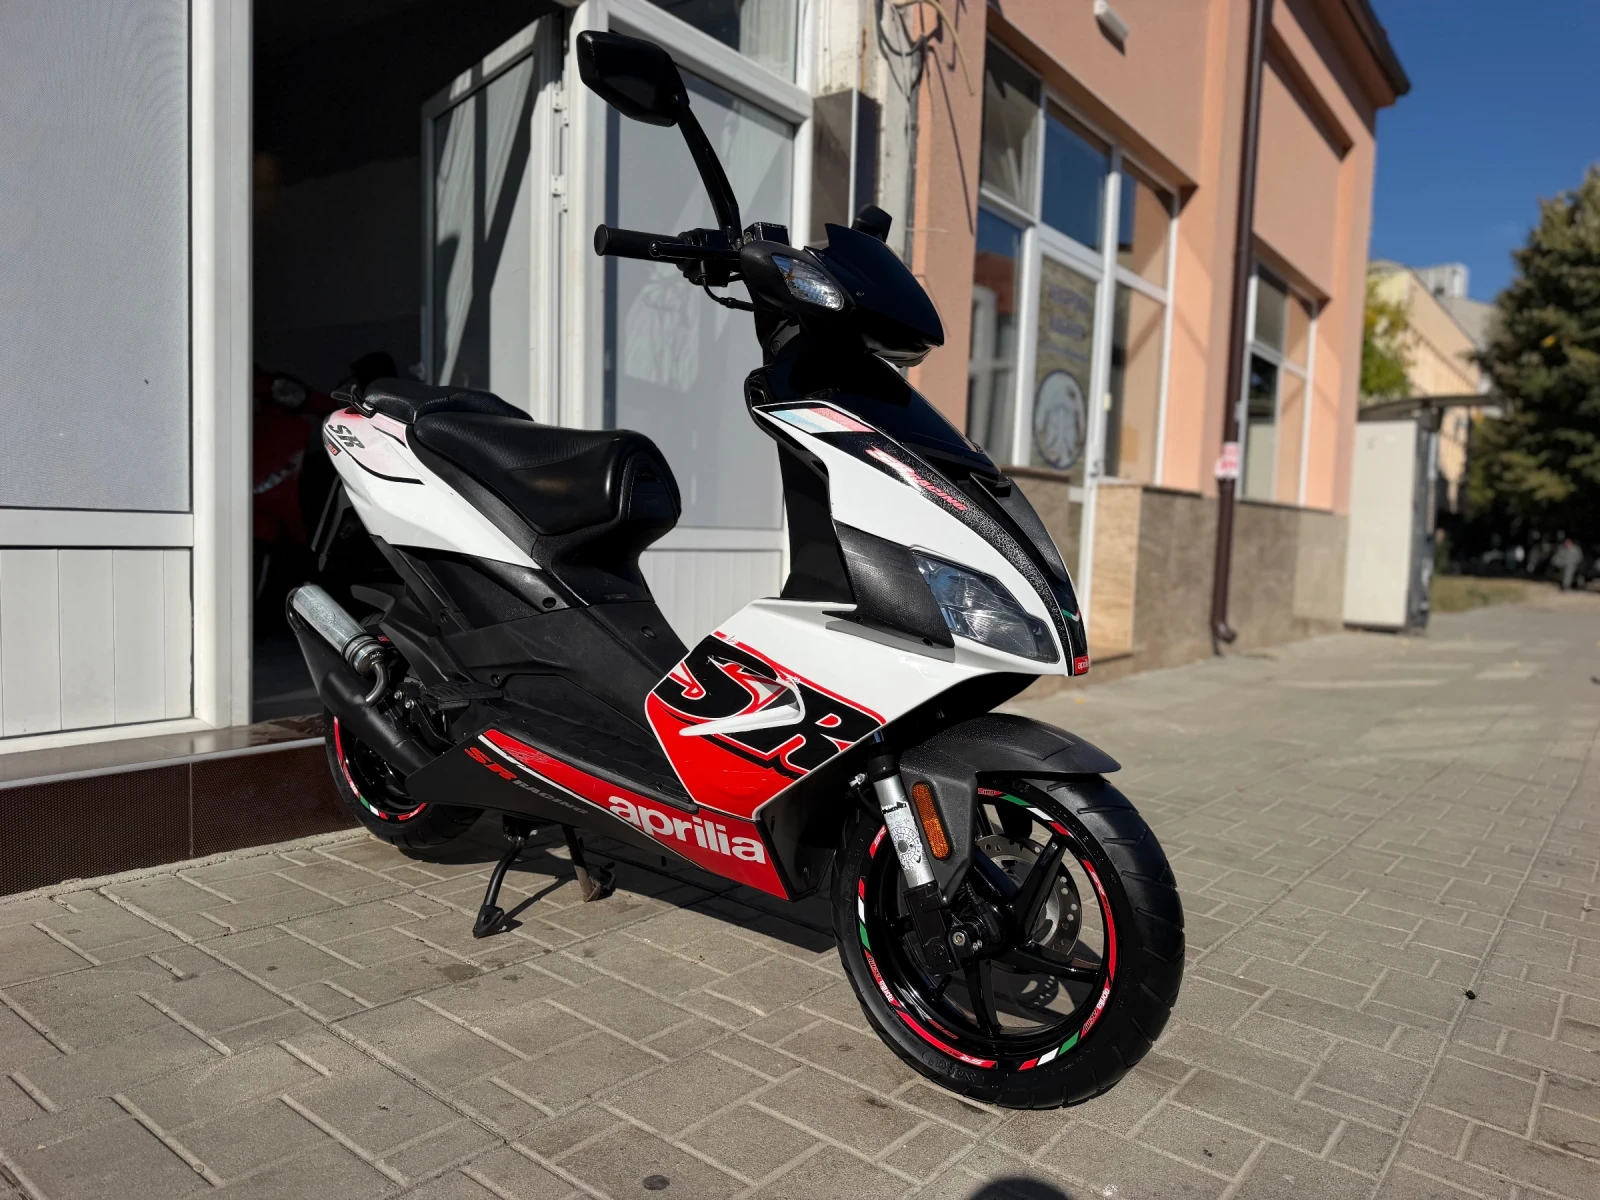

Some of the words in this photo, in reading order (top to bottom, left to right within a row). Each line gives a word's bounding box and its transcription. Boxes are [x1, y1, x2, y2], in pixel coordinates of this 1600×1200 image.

[327, 424, 365, 449] SR
[910, 473, 968, 511] RACING
[463, 746, 518, 782] SR
[511, 778, 589, 814] RACING
[607, 794, 767, 866] aprilia
